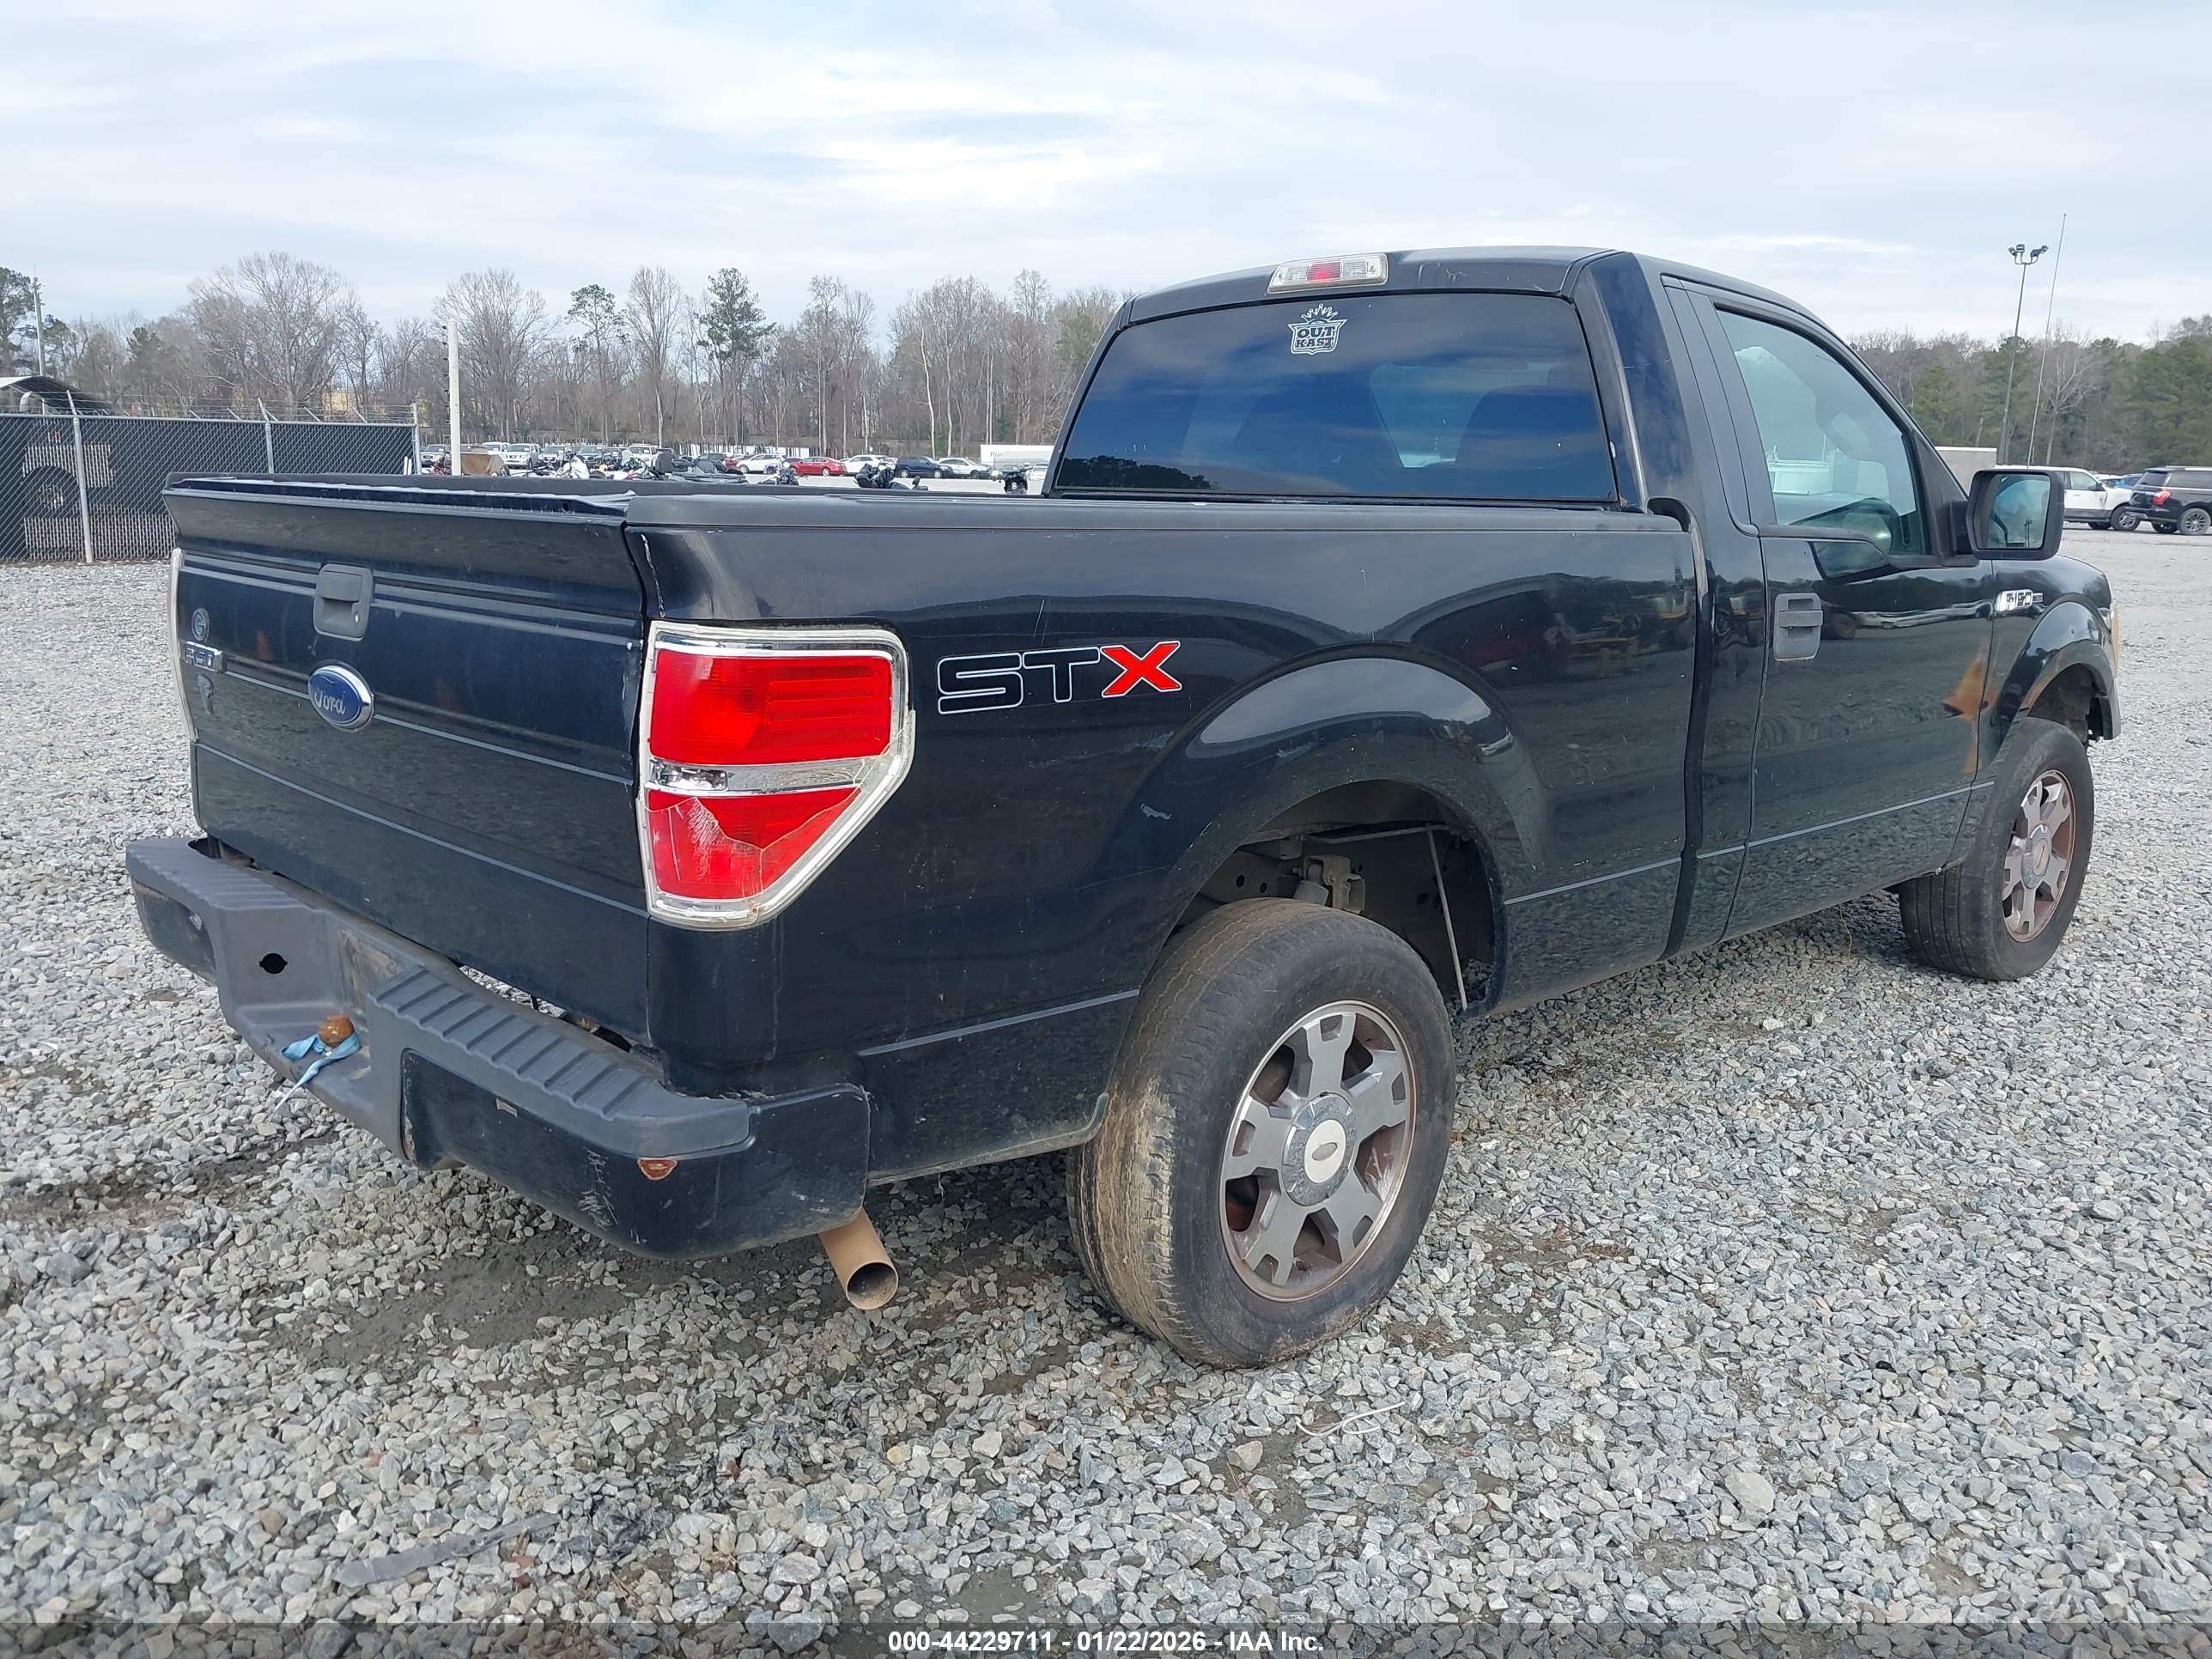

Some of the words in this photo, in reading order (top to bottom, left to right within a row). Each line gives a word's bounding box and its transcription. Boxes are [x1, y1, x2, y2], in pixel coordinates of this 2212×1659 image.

[1297, 326, 1336, 338] OUT
[1295, 337, 1334, 348] KAST
[937, 640, 1182, 714] STX
